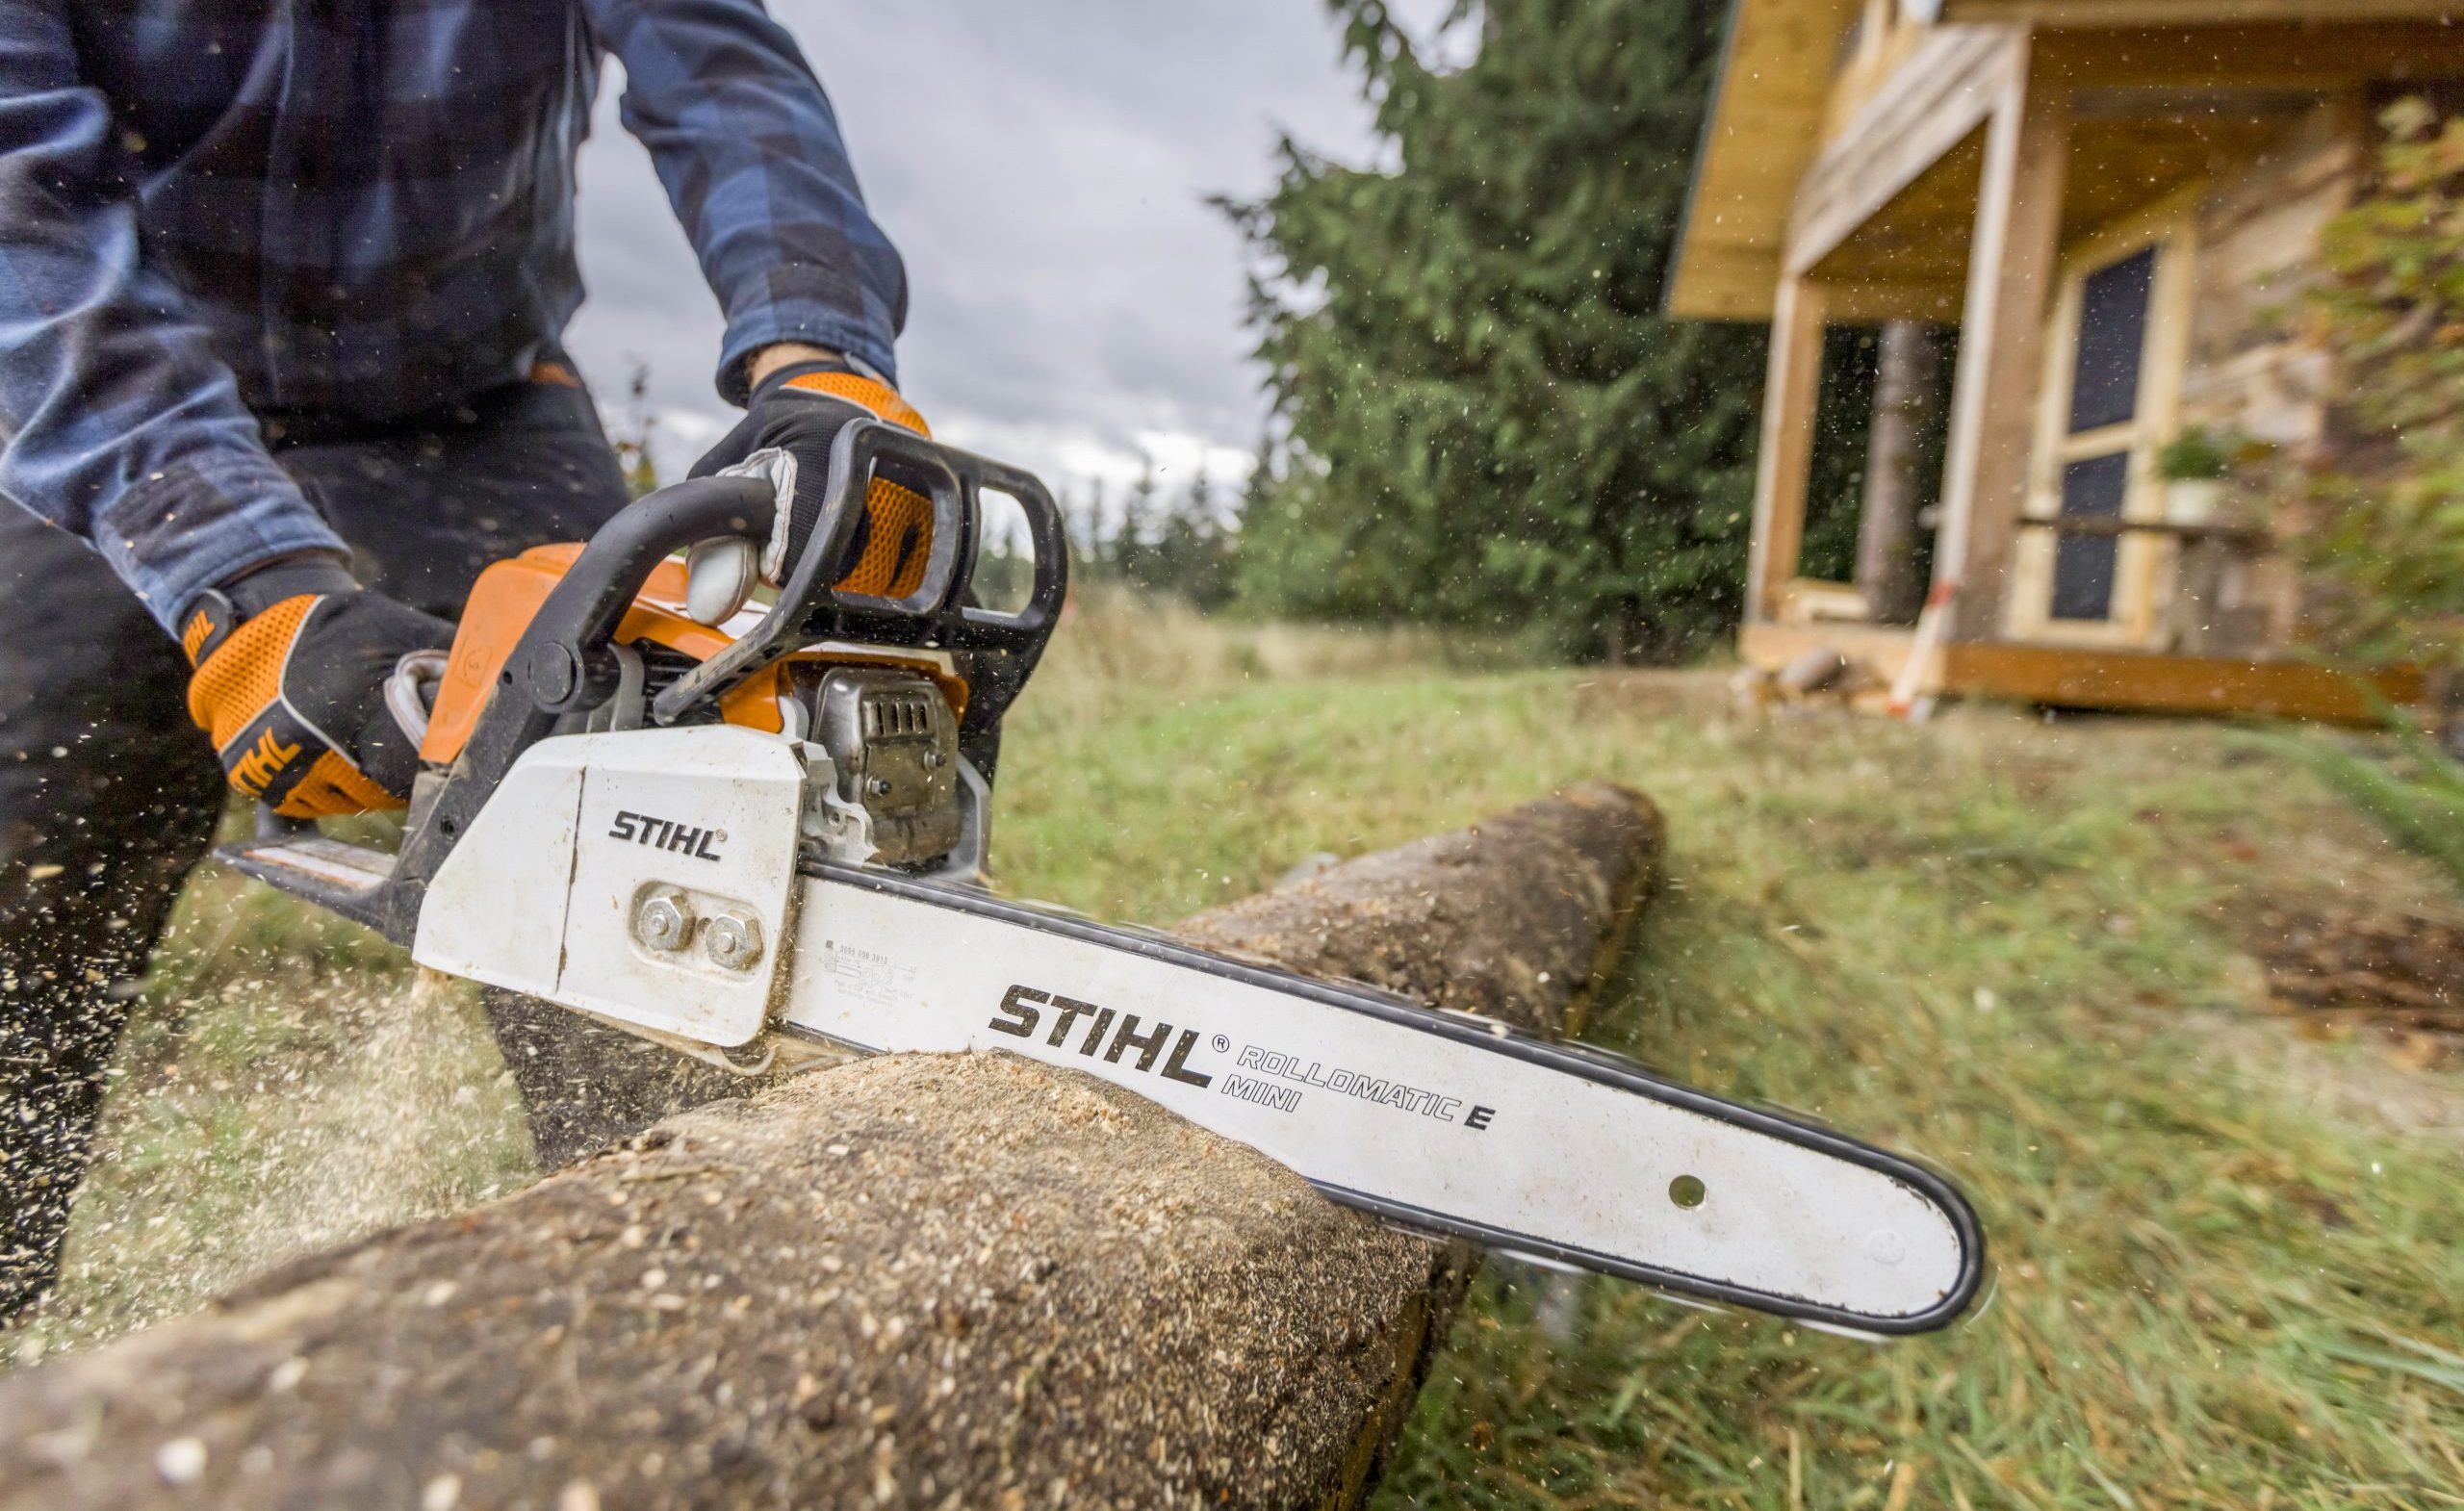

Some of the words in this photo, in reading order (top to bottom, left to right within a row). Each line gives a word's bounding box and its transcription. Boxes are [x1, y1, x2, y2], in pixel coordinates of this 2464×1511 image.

[1221, 1074, 1302, 1113] MINI
[1237, 1045, 1462, 1121] ROLLOMATIC
[1464, 1105, 1496, 1131] E
